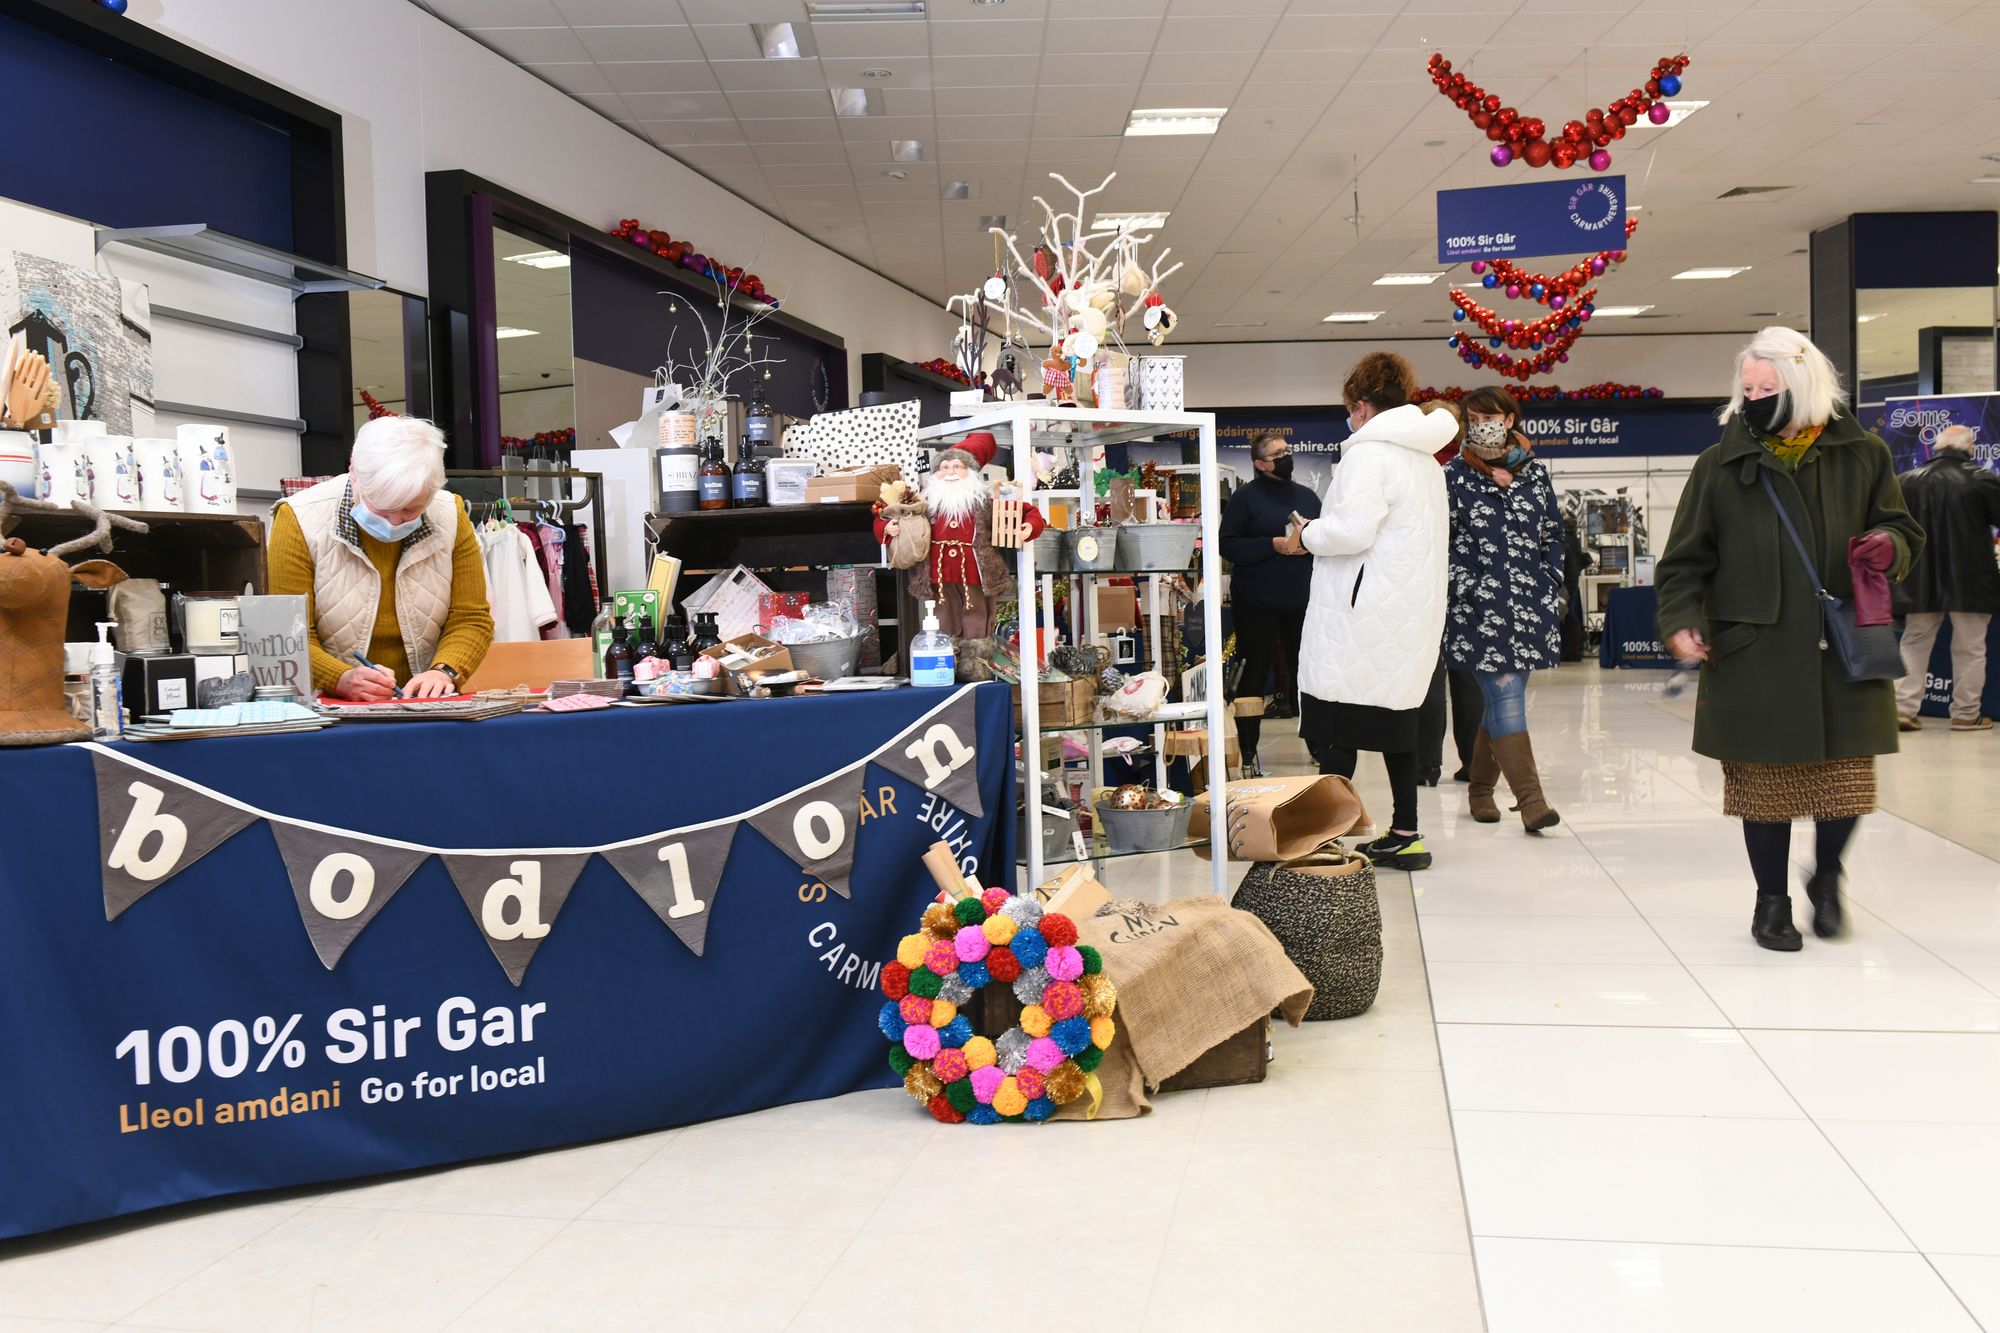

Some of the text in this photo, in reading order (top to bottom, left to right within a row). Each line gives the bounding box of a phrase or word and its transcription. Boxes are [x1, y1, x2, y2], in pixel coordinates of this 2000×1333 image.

[1568, 196, 1578, 210] SIR
[1570, 184, 1618, 231] CARMARTHENSHIRE
[1446, 233, 1516, 248] 100% Sir Gâr
[1520, 417, 1619, 434] 100% Sir Gâr
[1890, 408, 1951, 428] Some
[1572, 437, 1582, 445] Go
[1585, 436, 1597, 445] for
[1599, 435, 1619, 444] local
[1622, 641, 1650, 652] 100%
[1924, 672, 1952, 690] Gar
[1930, 692, 1950, 703] local
[115, 996, 546, 1085] 100% Sir Gar
[119, 1056, 545, 1134] Lleol amdani Go for local
